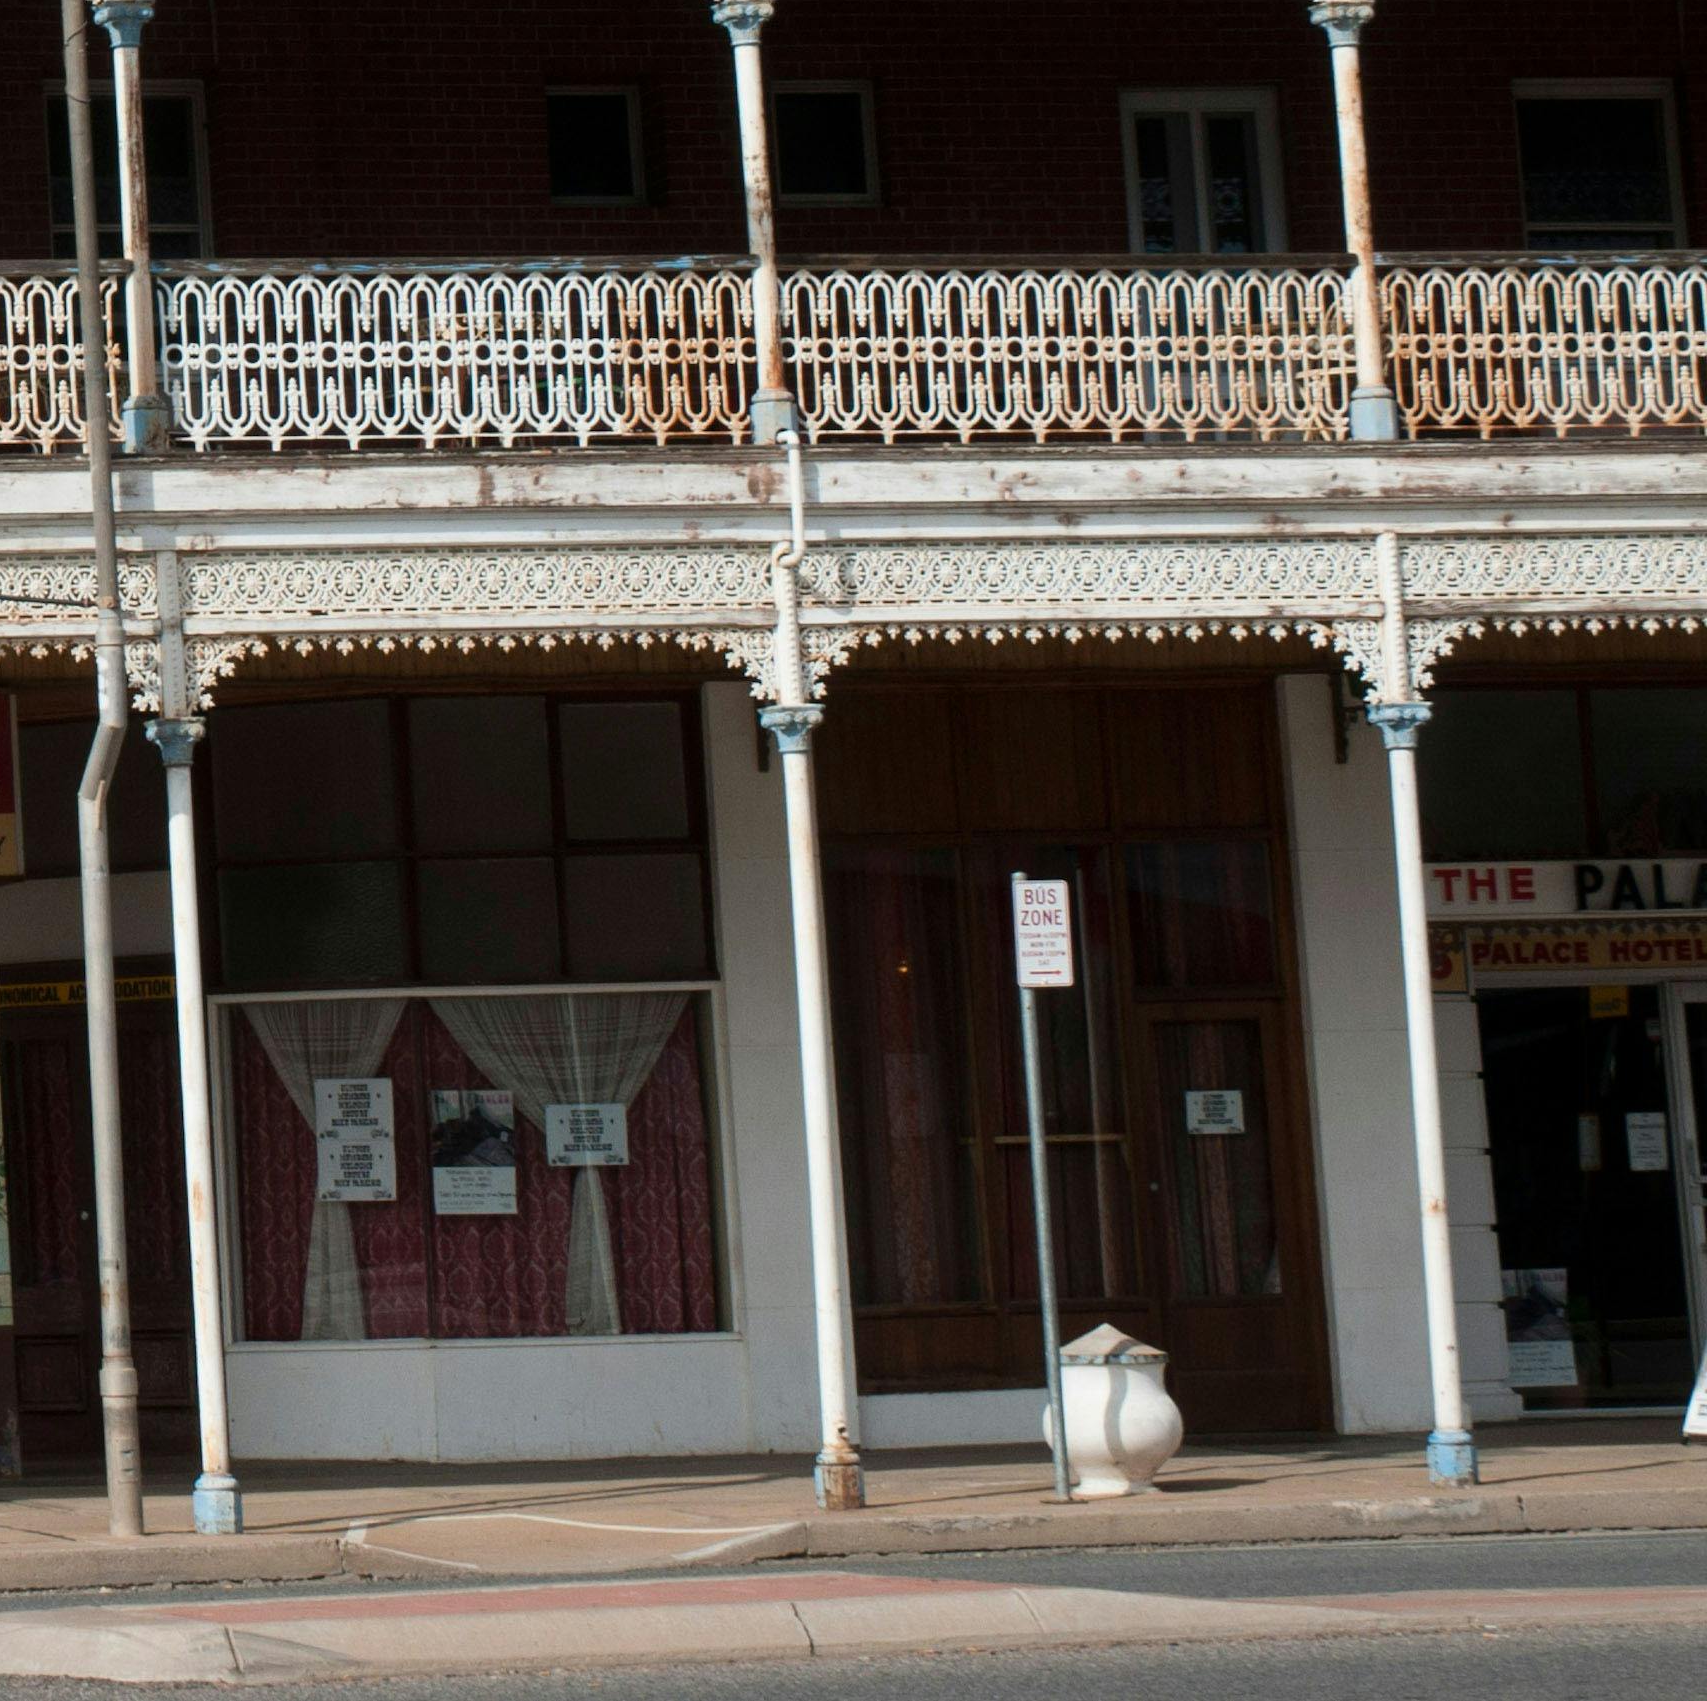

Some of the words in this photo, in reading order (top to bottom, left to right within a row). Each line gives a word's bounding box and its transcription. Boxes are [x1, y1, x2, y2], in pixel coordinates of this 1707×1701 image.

[1434, 868, 1535, 900] THE
[1024, 889, 1056, 905] BUS
[1021, 910, 1062, 926] ZONE
[1471, 941, 1590, 965] PALACE
